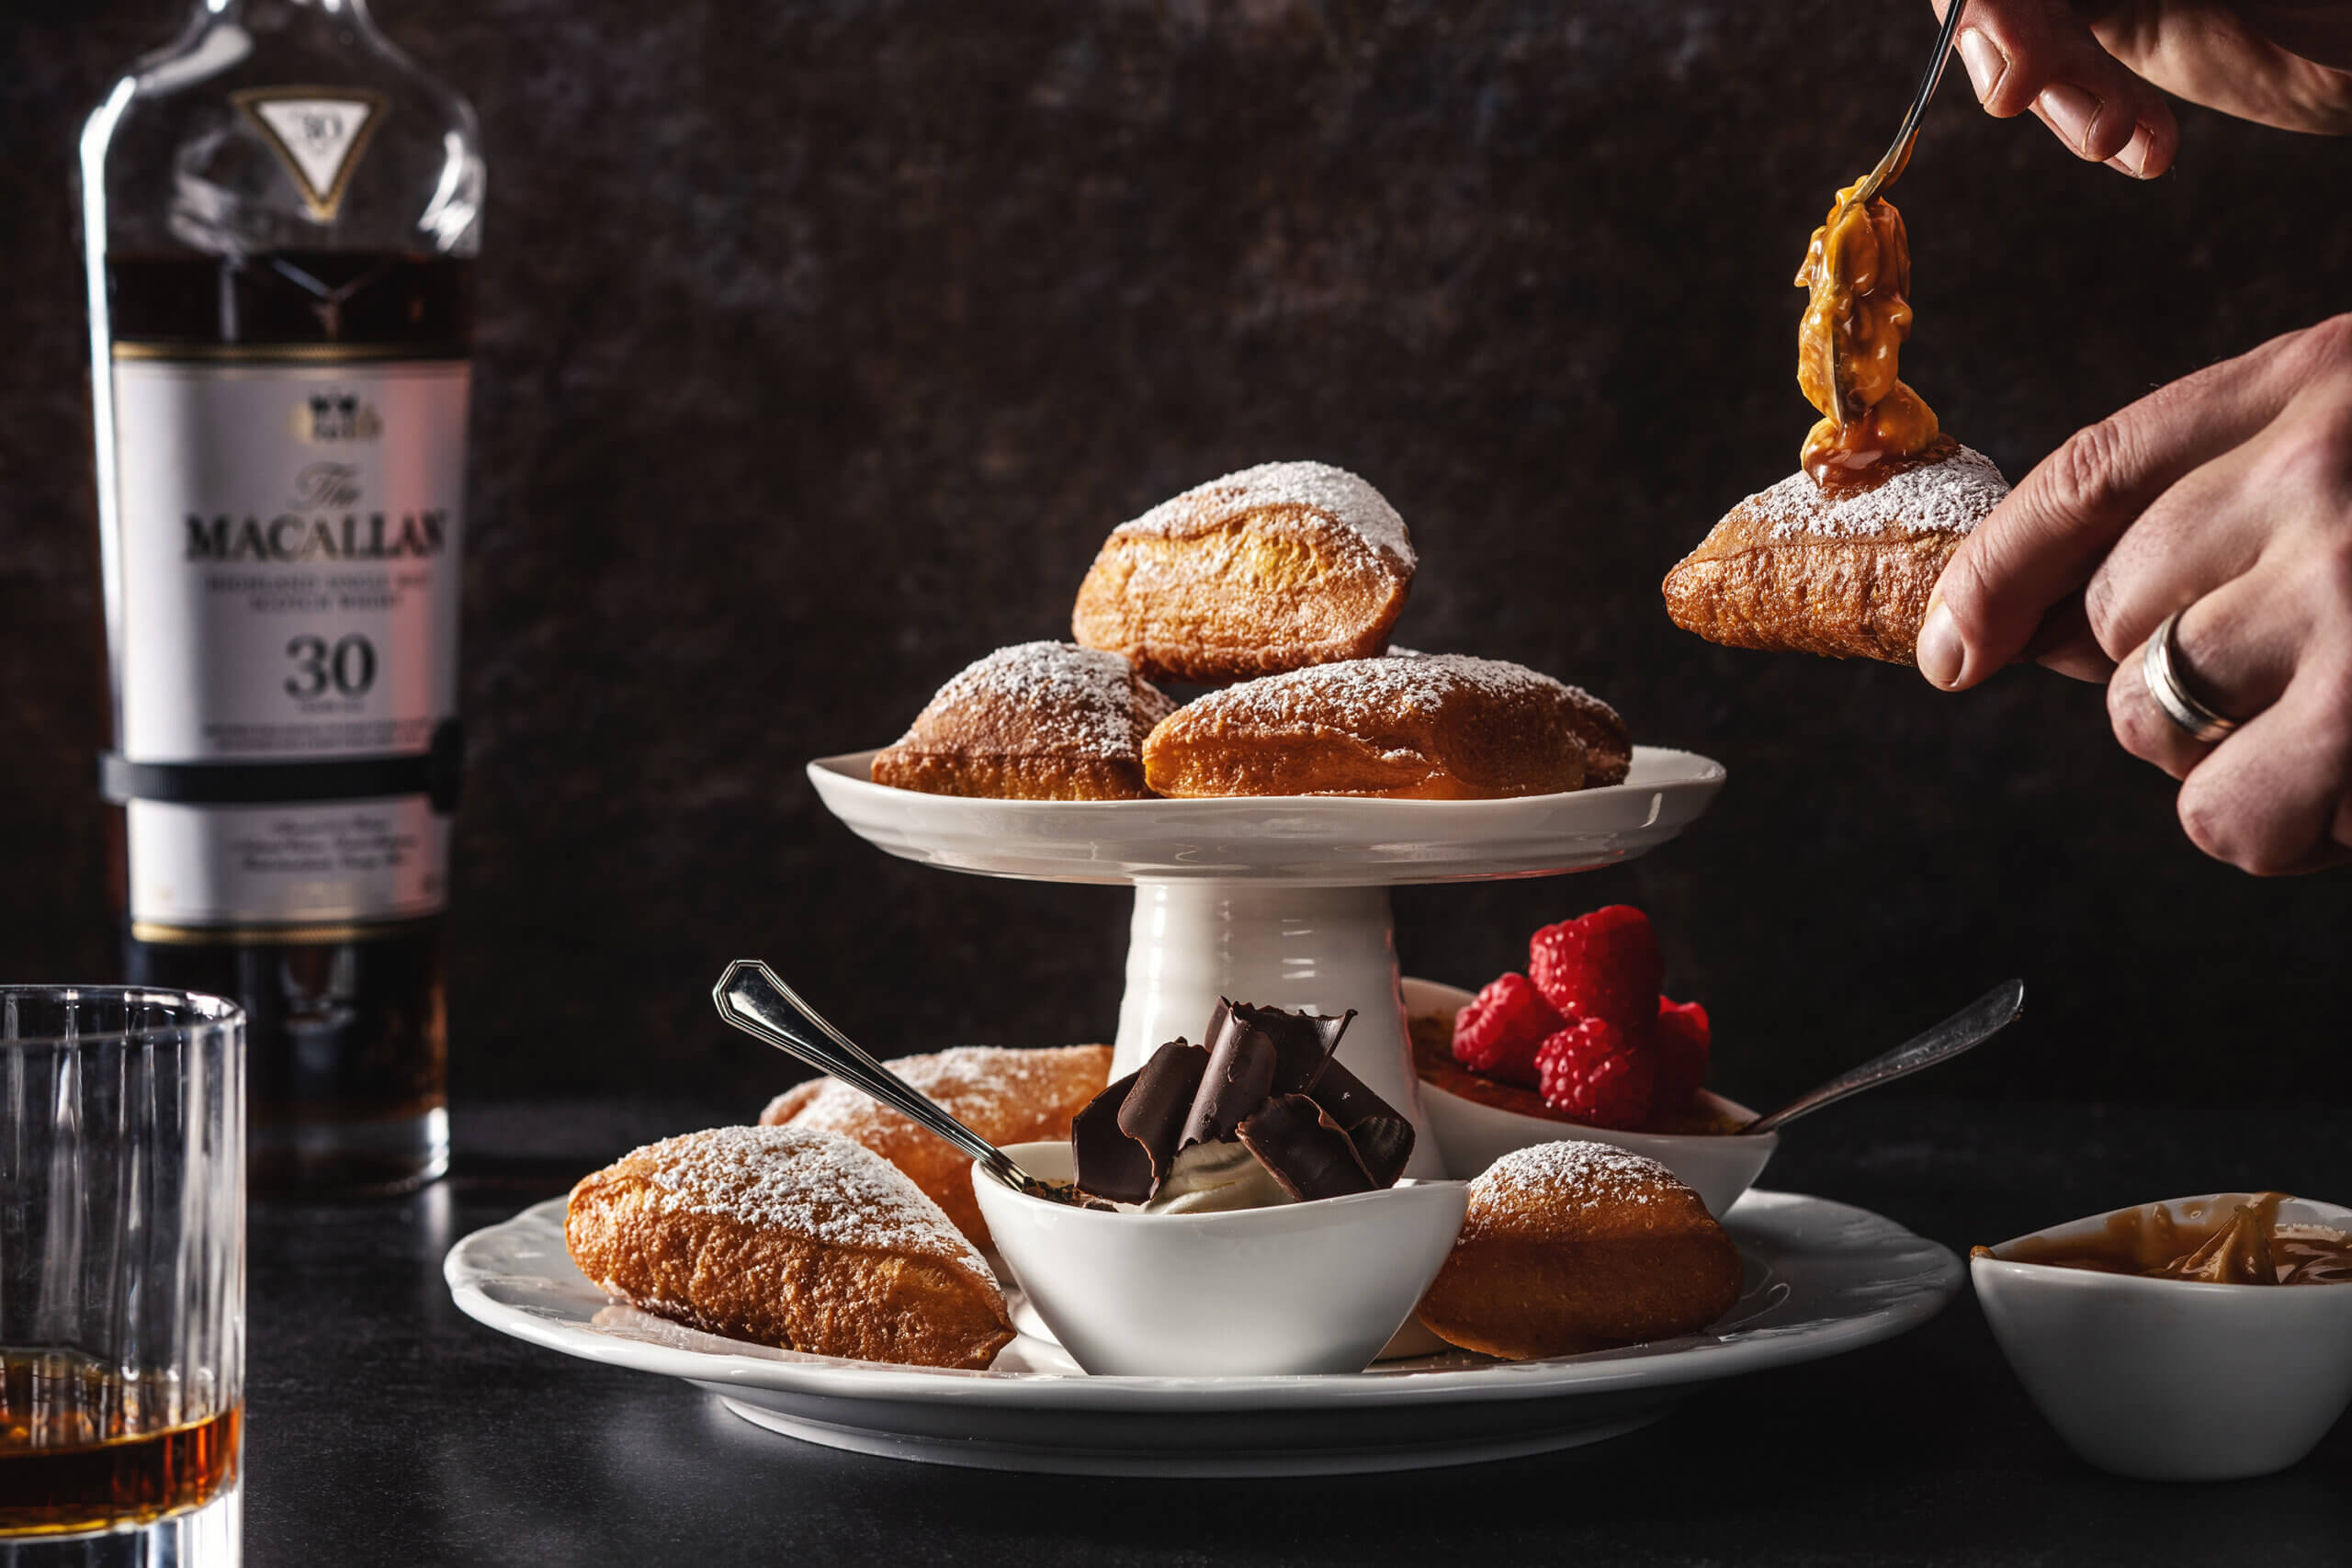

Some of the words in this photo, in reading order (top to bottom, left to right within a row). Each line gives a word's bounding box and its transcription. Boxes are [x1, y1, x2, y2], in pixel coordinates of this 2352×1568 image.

[288, 460, 362, 513] The
[186, 509, 447, 562] MACALLAN
[284, 633, 379, 700] 30
